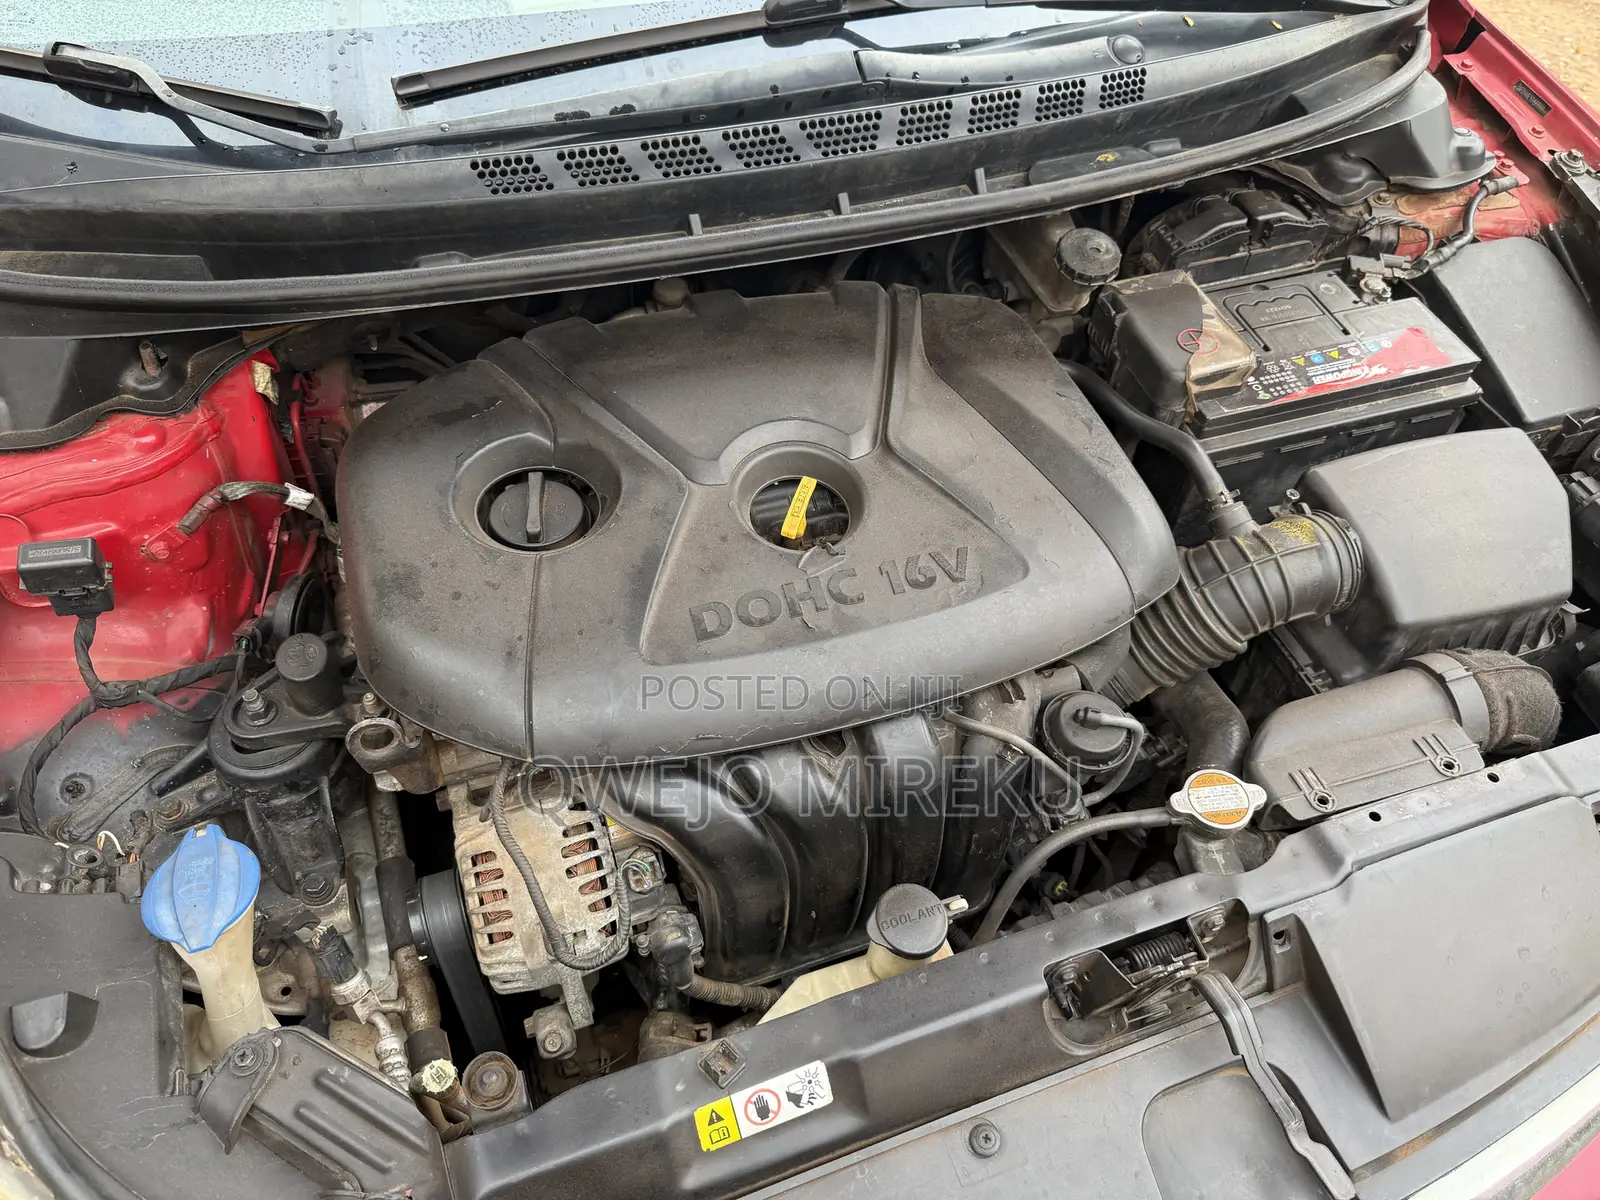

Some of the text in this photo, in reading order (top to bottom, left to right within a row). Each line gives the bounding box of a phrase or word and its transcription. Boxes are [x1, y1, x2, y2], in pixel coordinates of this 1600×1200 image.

[690, 546, 970, 643] DOHC 16V
[880, 904, 944, 932] COOLANT
